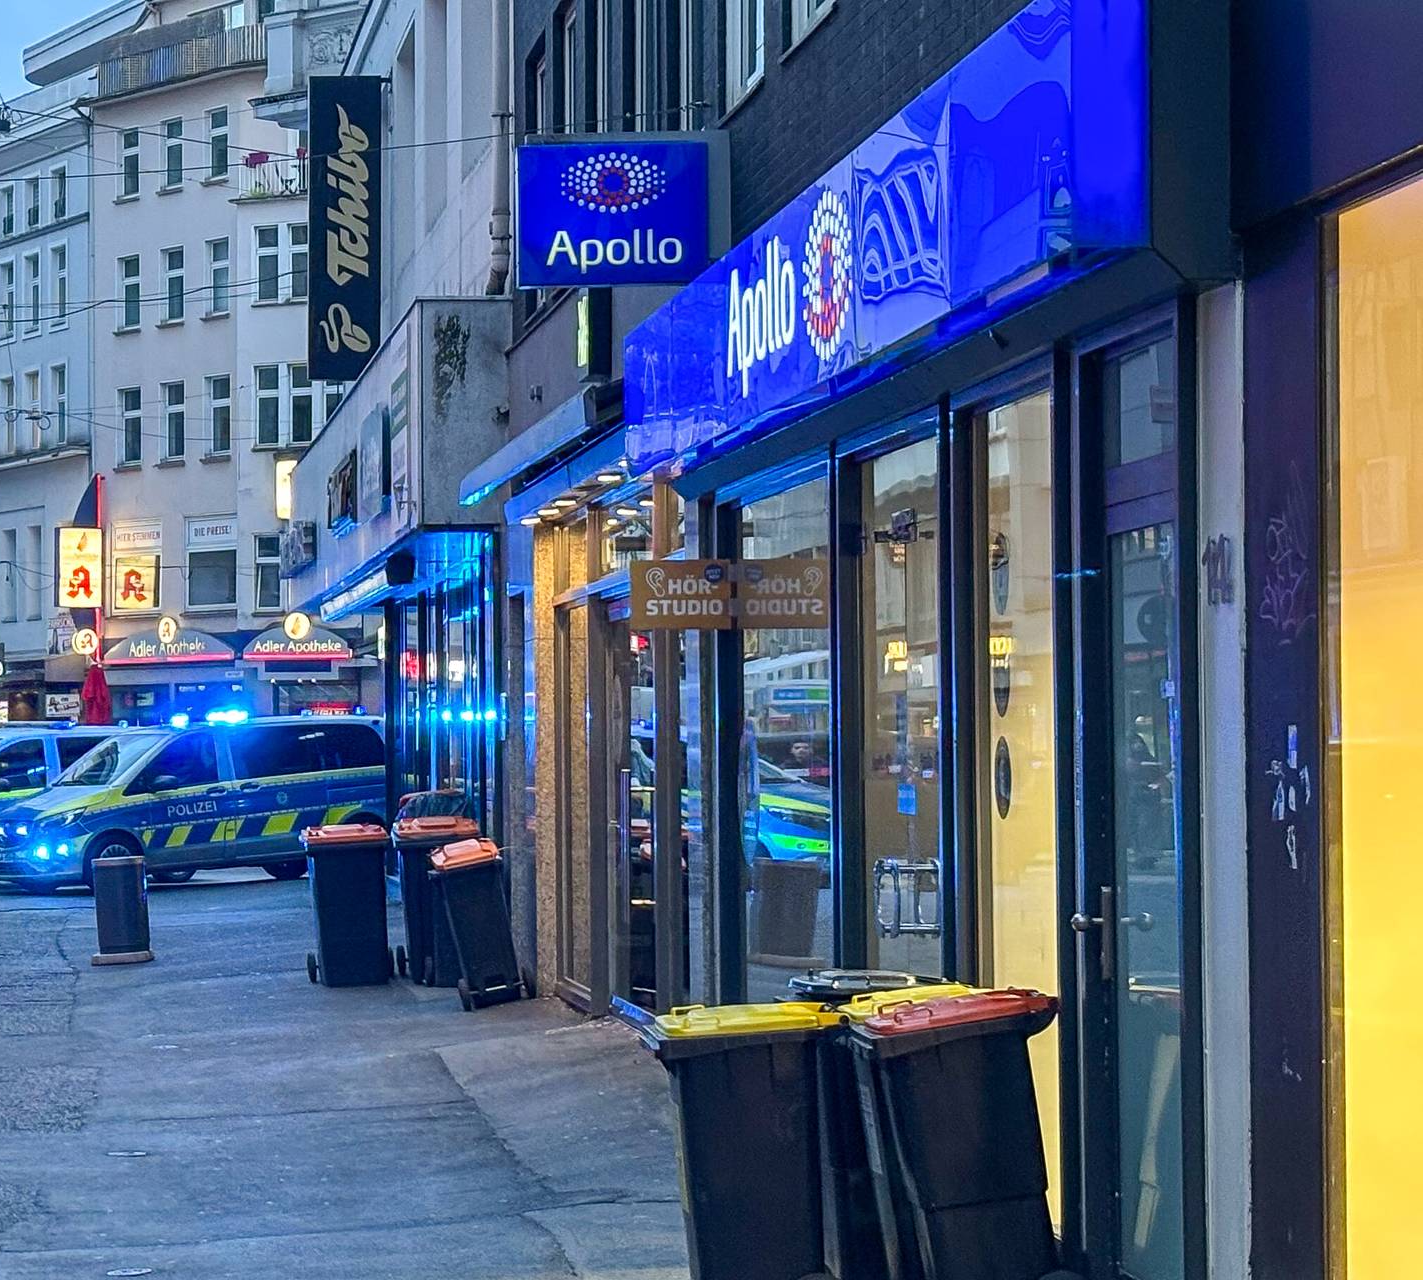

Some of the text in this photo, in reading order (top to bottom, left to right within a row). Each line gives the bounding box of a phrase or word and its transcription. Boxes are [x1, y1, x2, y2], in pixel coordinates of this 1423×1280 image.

[327, 103, 370, 287] Tchibo
[545, 228, 683, 274] Apollo
[727, 235, 797, 399] Apollo
[193, 525, 232, 537] DIE PREISE!
[668, 574, 719, 595] HÖR-
[645, 599, 724, 616] STUDIO
[128, 639, 157, 658] Adler
[253, 638, 342, 654] Adler Apotheke
[166, 800, 218, 818] POLIZEI
